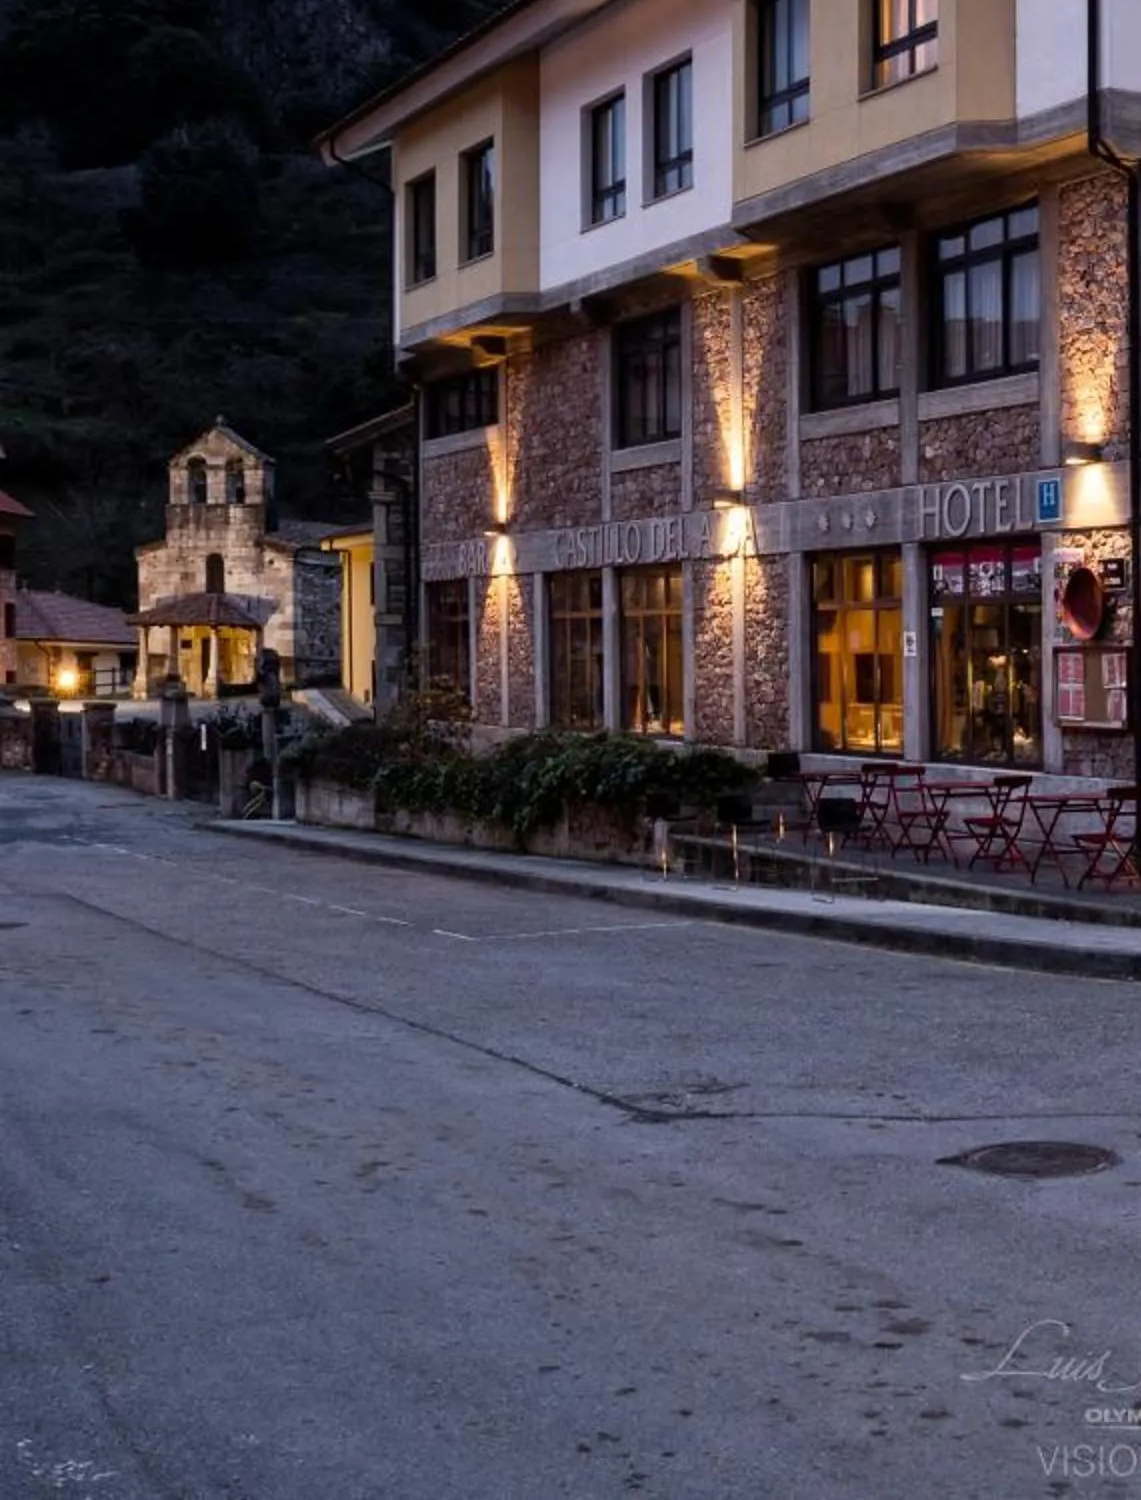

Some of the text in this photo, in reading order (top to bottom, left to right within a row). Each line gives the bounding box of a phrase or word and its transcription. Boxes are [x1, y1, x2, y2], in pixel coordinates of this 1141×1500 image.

[918, 477, 1032, 538] HOTEL
[1043, 483, 1055, 506] H
[554, 520, 641, 567] CASTILLO
[651, 514, 688, 560] DEL
